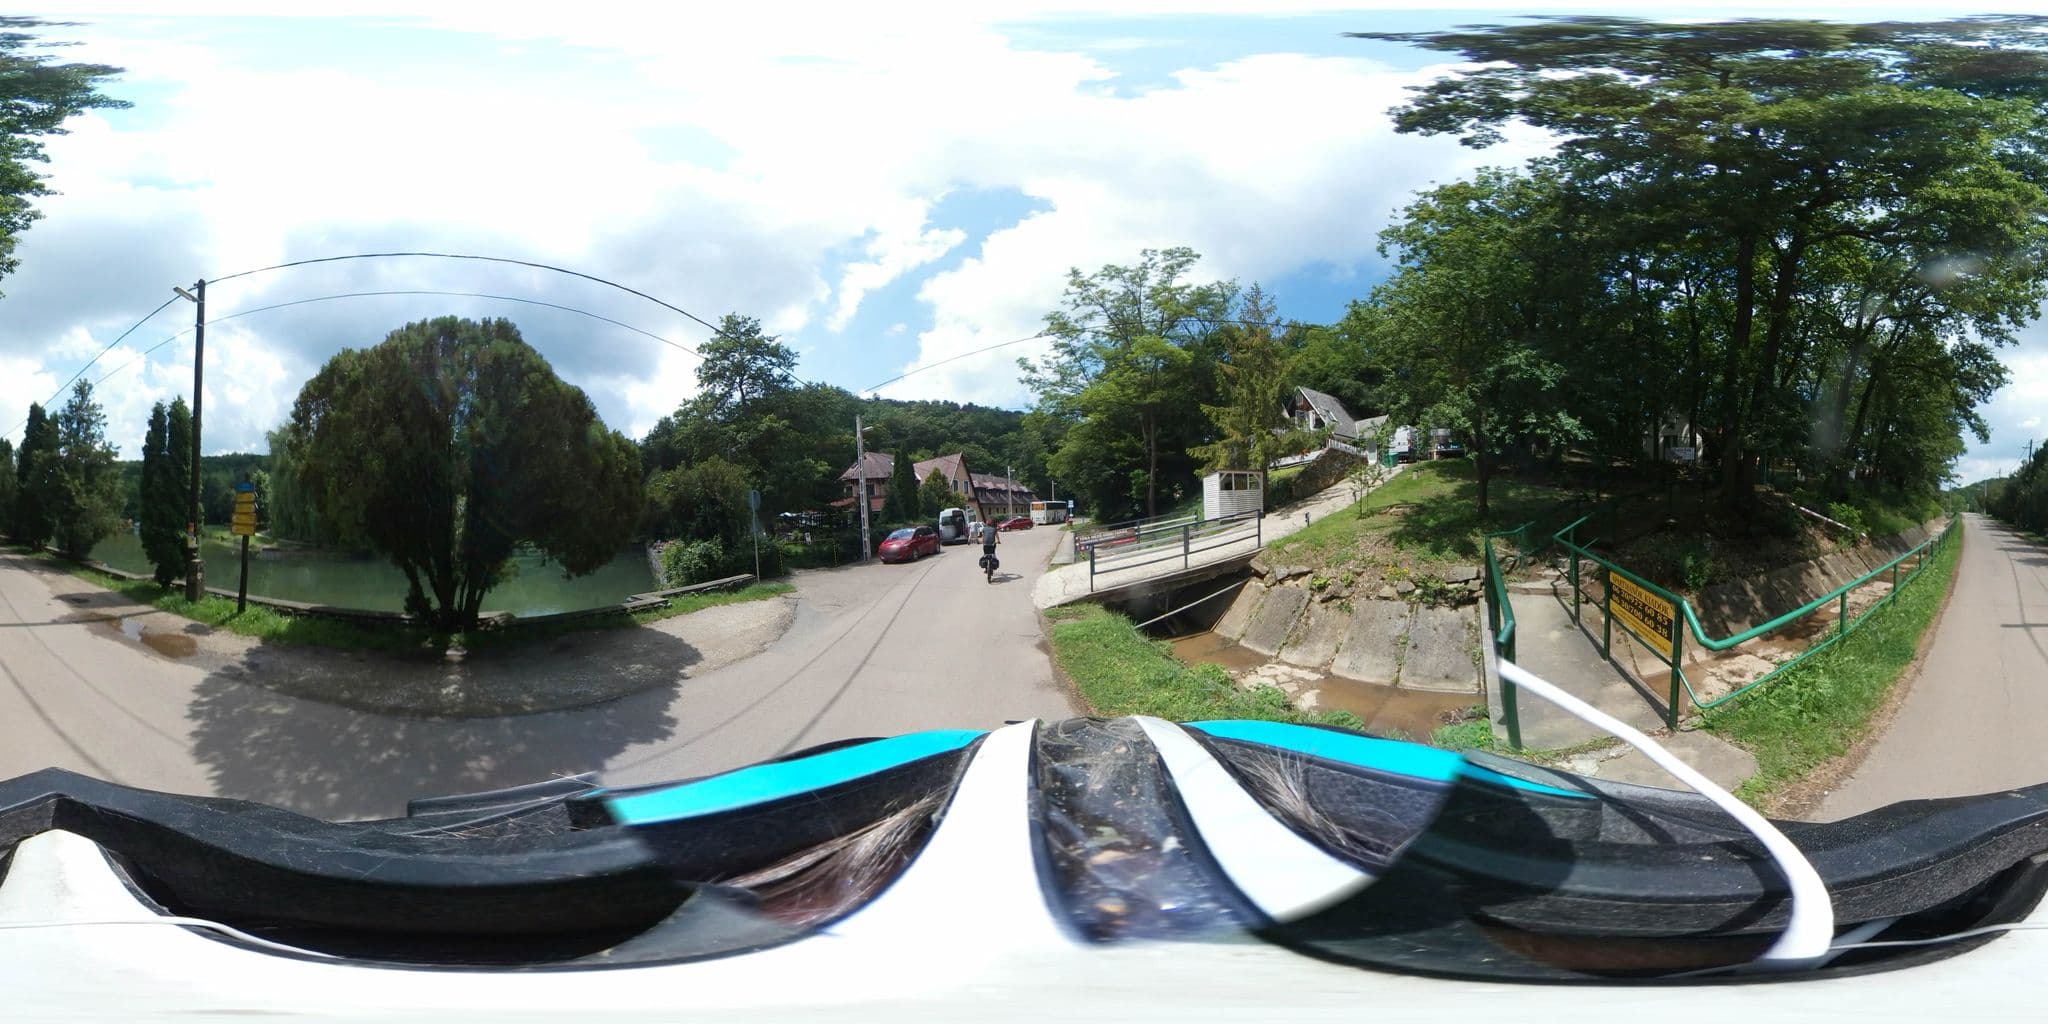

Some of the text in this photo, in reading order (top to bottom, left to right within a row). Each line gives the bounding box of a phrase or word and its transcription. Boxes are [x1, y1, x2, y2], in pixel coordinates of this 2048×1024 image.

[1645, 606, 1654, 617] 60
[1657, 613, 1668, 625] 85
[1645, 617, 1654, 628] 60
